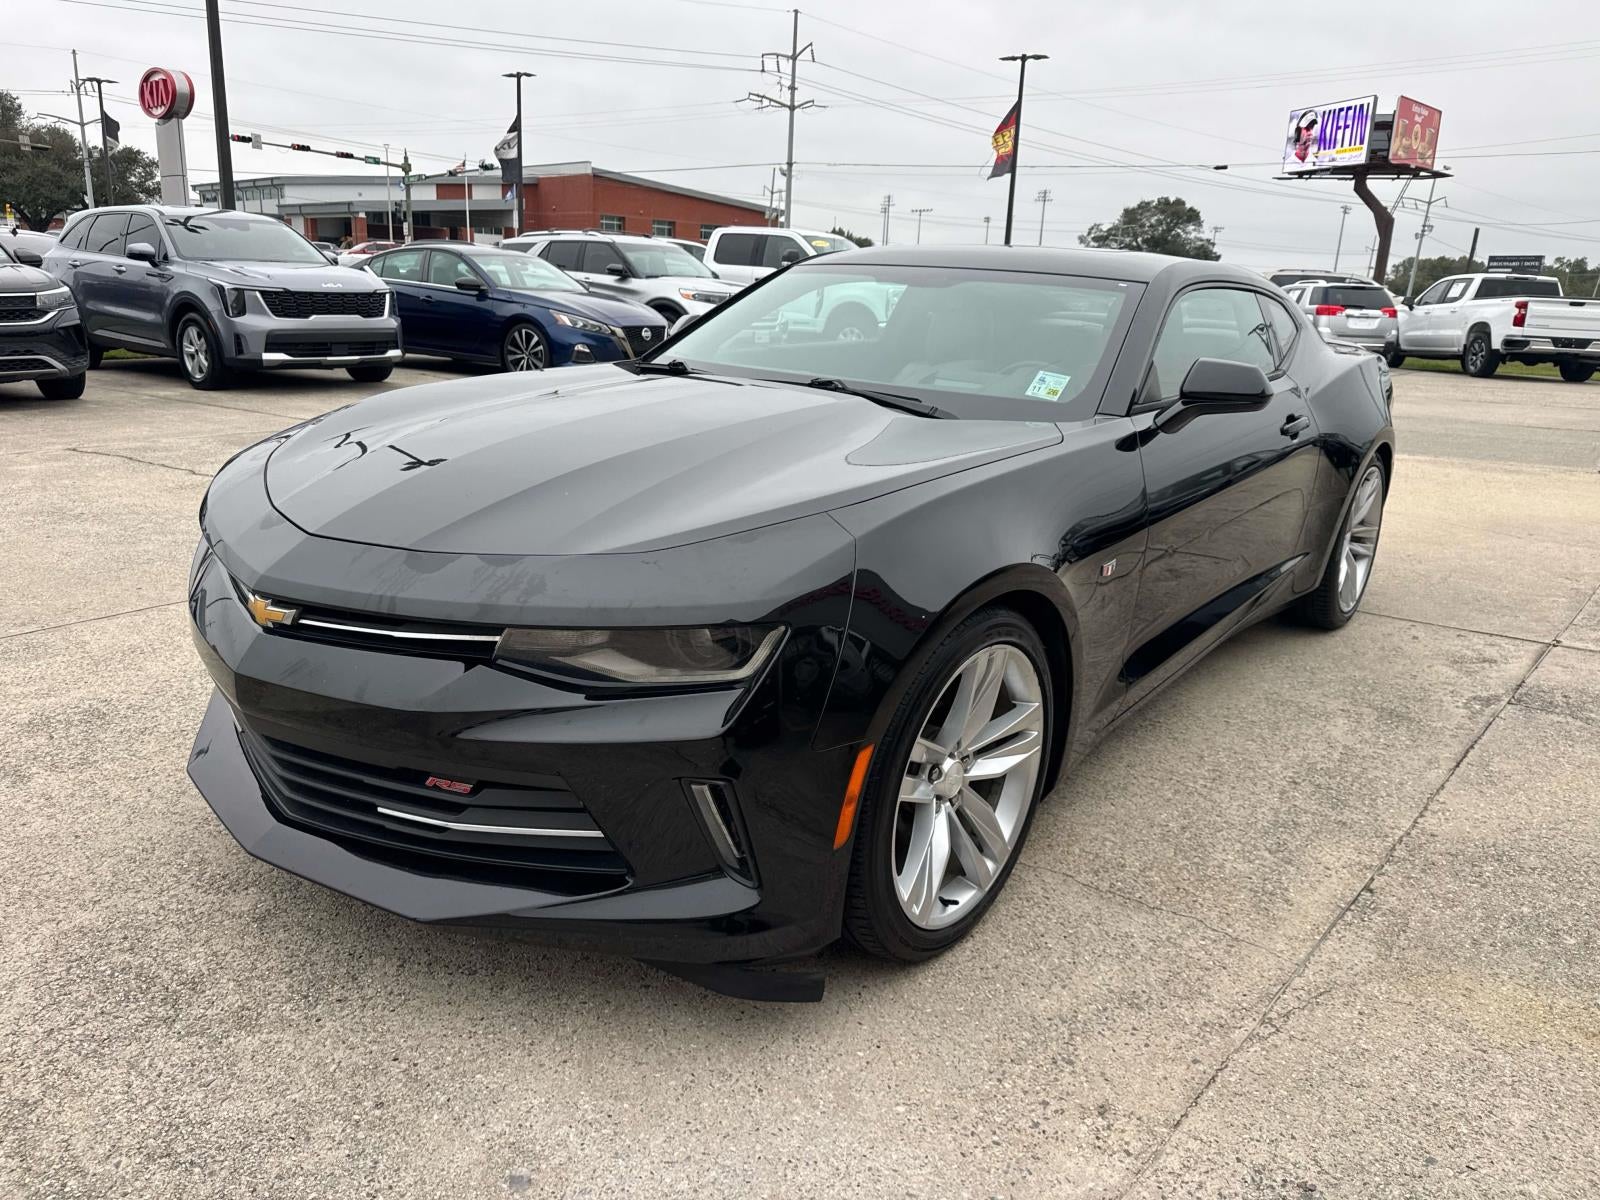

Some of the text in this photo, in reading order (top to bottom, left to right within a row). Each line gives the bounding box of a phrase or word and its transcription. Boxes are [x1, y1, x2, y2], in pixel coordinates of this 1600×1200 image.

[143, 78, 167, 109] KIA
[1318, 102, 1370, 151] KIFFIN
[425, 776, 474, 794] RS
